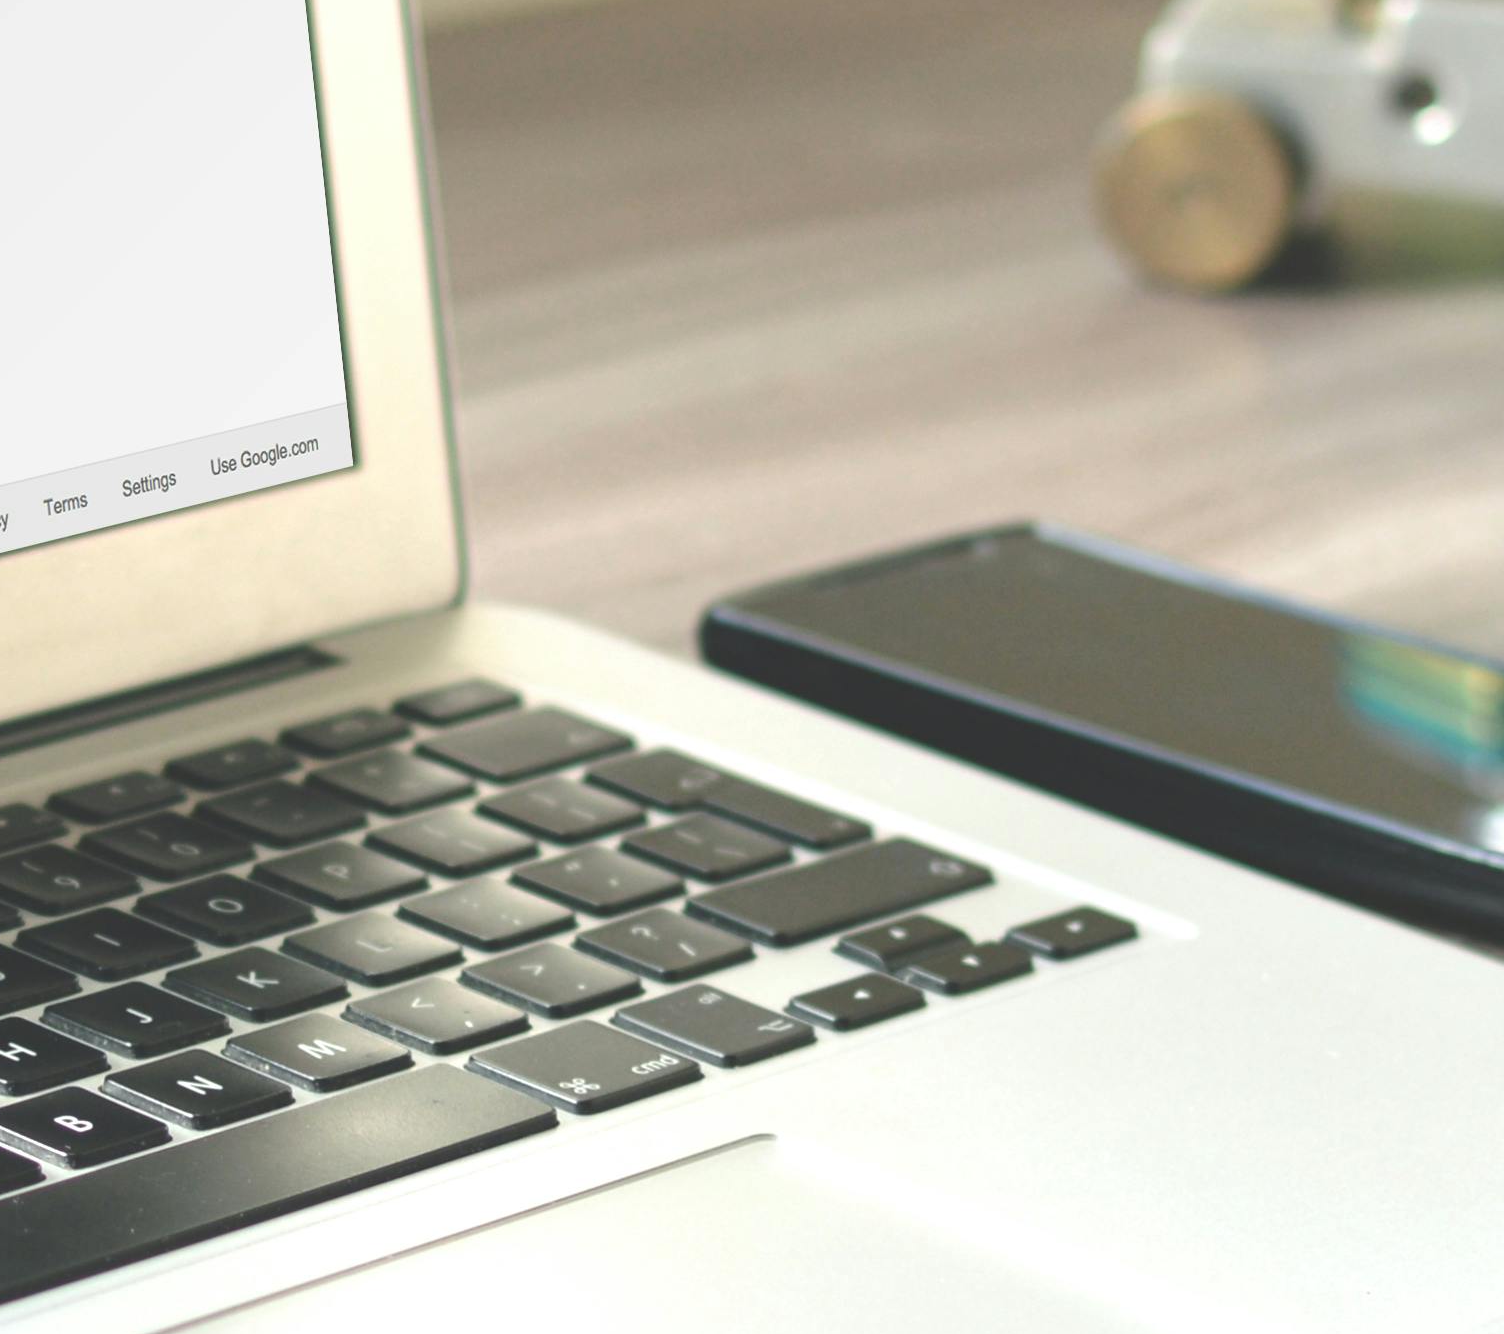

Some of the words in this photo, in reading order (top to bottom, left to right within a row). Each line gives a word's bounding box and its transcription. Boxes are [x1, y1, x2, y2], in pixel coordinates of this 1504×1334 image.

[211, 459, 237, 475] Use
[241, 439, 318, 468] Google.com
[123, 474, 176, 497] Settings
[43, 495, 88, 515] Terms
[54, 877, 80, 888] 9
[209, 899, 243, 912] O
[94, 934, 120, 946] I
[238, 972, 278, 988] K
[127, 1009, 152, 1023] J
[298, 1038, 347, 1060] M
[631, 1054, 679, 1076] cmd
[177, 1076, 223, 1095] N
[54, 1116, 93, 1132] B
